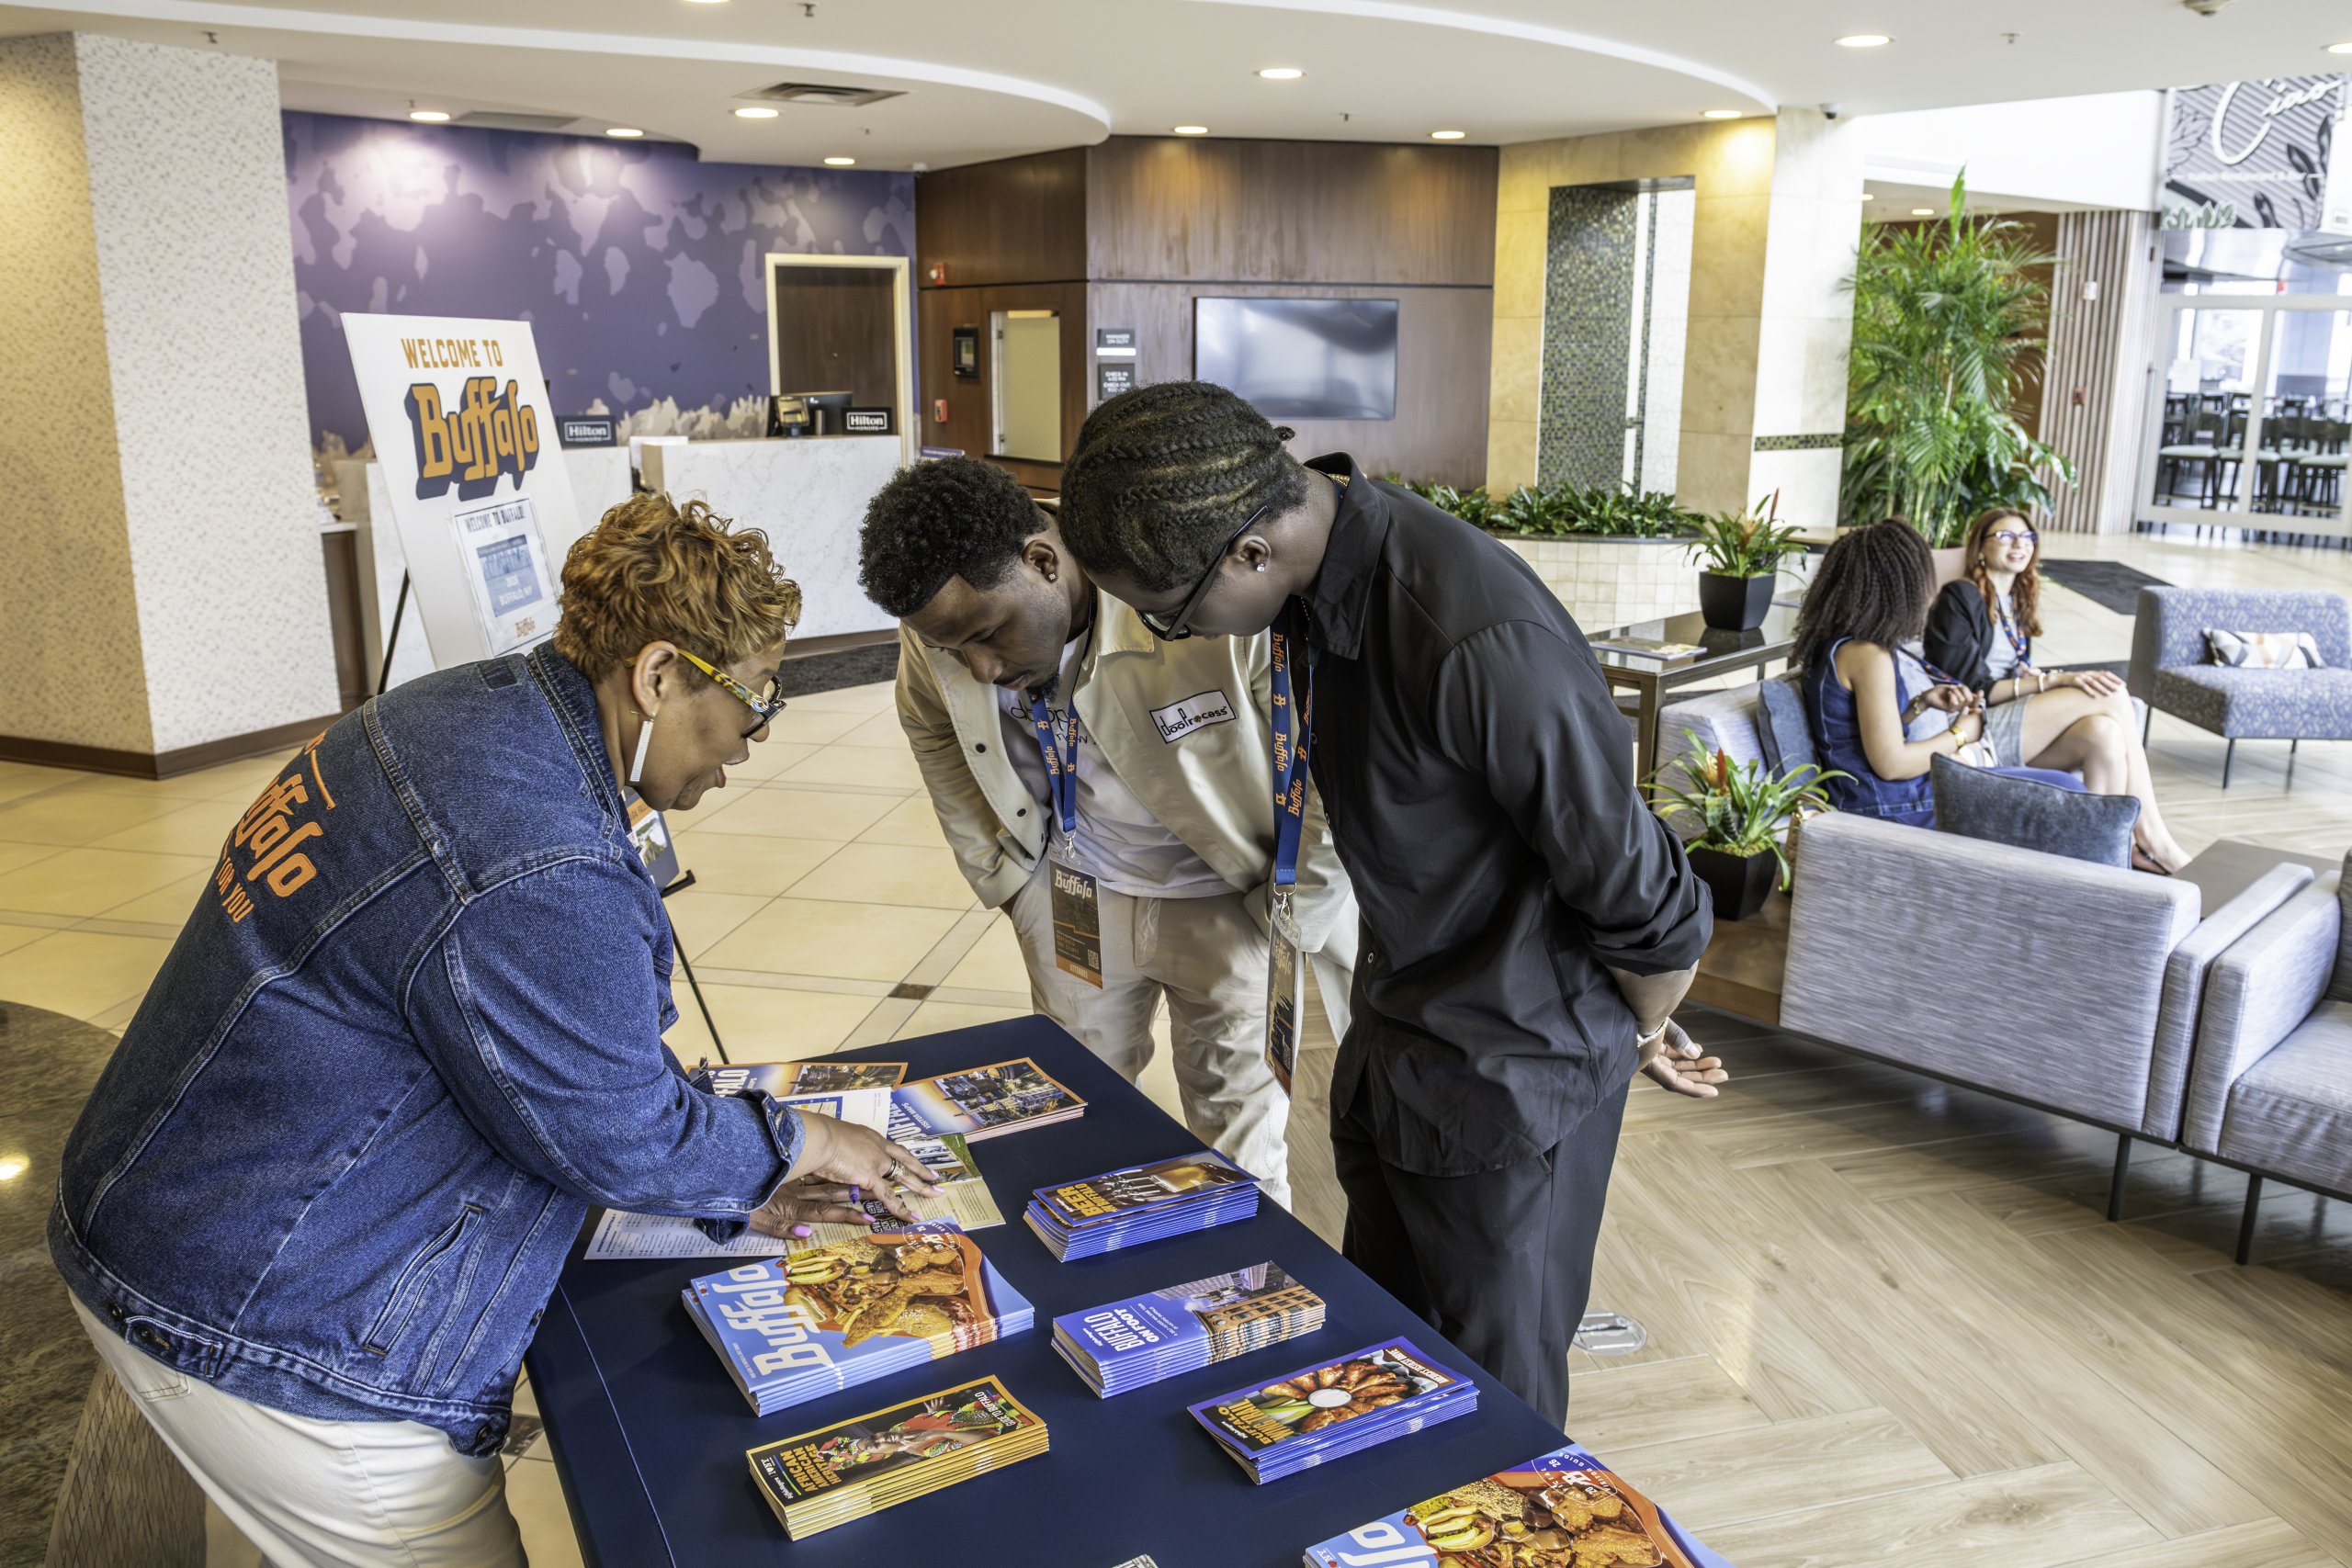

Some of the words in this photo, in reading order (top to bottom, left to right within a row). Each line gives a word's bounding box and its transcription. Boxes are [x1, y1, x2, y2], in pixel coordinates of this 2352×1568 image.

[401, 339, 481, 368] WELCOME
[482, 340, 503, 367] TO
[569, 426, 606, 437] Hilton
[851, 416, 884, 426] Hilton
[404, 376, 540, 502] Buffalo
[1273, 632, 1284, 672] Buffalo
[1069, 717, 1078, 747] Buffalo
[1045, 746, 1059, 774] Buffalo
[1275, 731, 1288, 773] Buffalo
[1288, 778, 1303, 818] Buffalo
[1054, 868, 1092, 899] Buffalo
[221, 882, 254, 923] YOU
[901, 1102, 916, 1115] MAPS
[913, 1112, 932, 1130] VISITOR
[1057, 1185, 1104, 1217] BEER
[711, 1264, 834, 1376] Buffalo
[1083, 1312, 1146, 1352] BUFFALO
[1114, 1308, 1145, 1330] FOOT
[1138, 1325, 1159, 1343] ON
[974, 1391, 999, 1413] BUFFALO
[991, 1409, 1003, 1417] TO
[1227, 1398, 1268, 1425] TRAIL
[1218, 1406, 1272, 1445] BUFFALO
[1252, 1418, 1295, 1442] WING
[779, 1450, 819, 1493] AFRICAN
[792, 1446, 831, 1488] AMERICAN
[804, 1443, 842, 1485] HERITAGE
[1548, 1458, 1561, 1468] 26
[1558, 1451, 1585, 1467] GUIDE
[1586, 1467, 1611, 1492] VISITOR
[1317, 1548, 1333, 1562] NY
